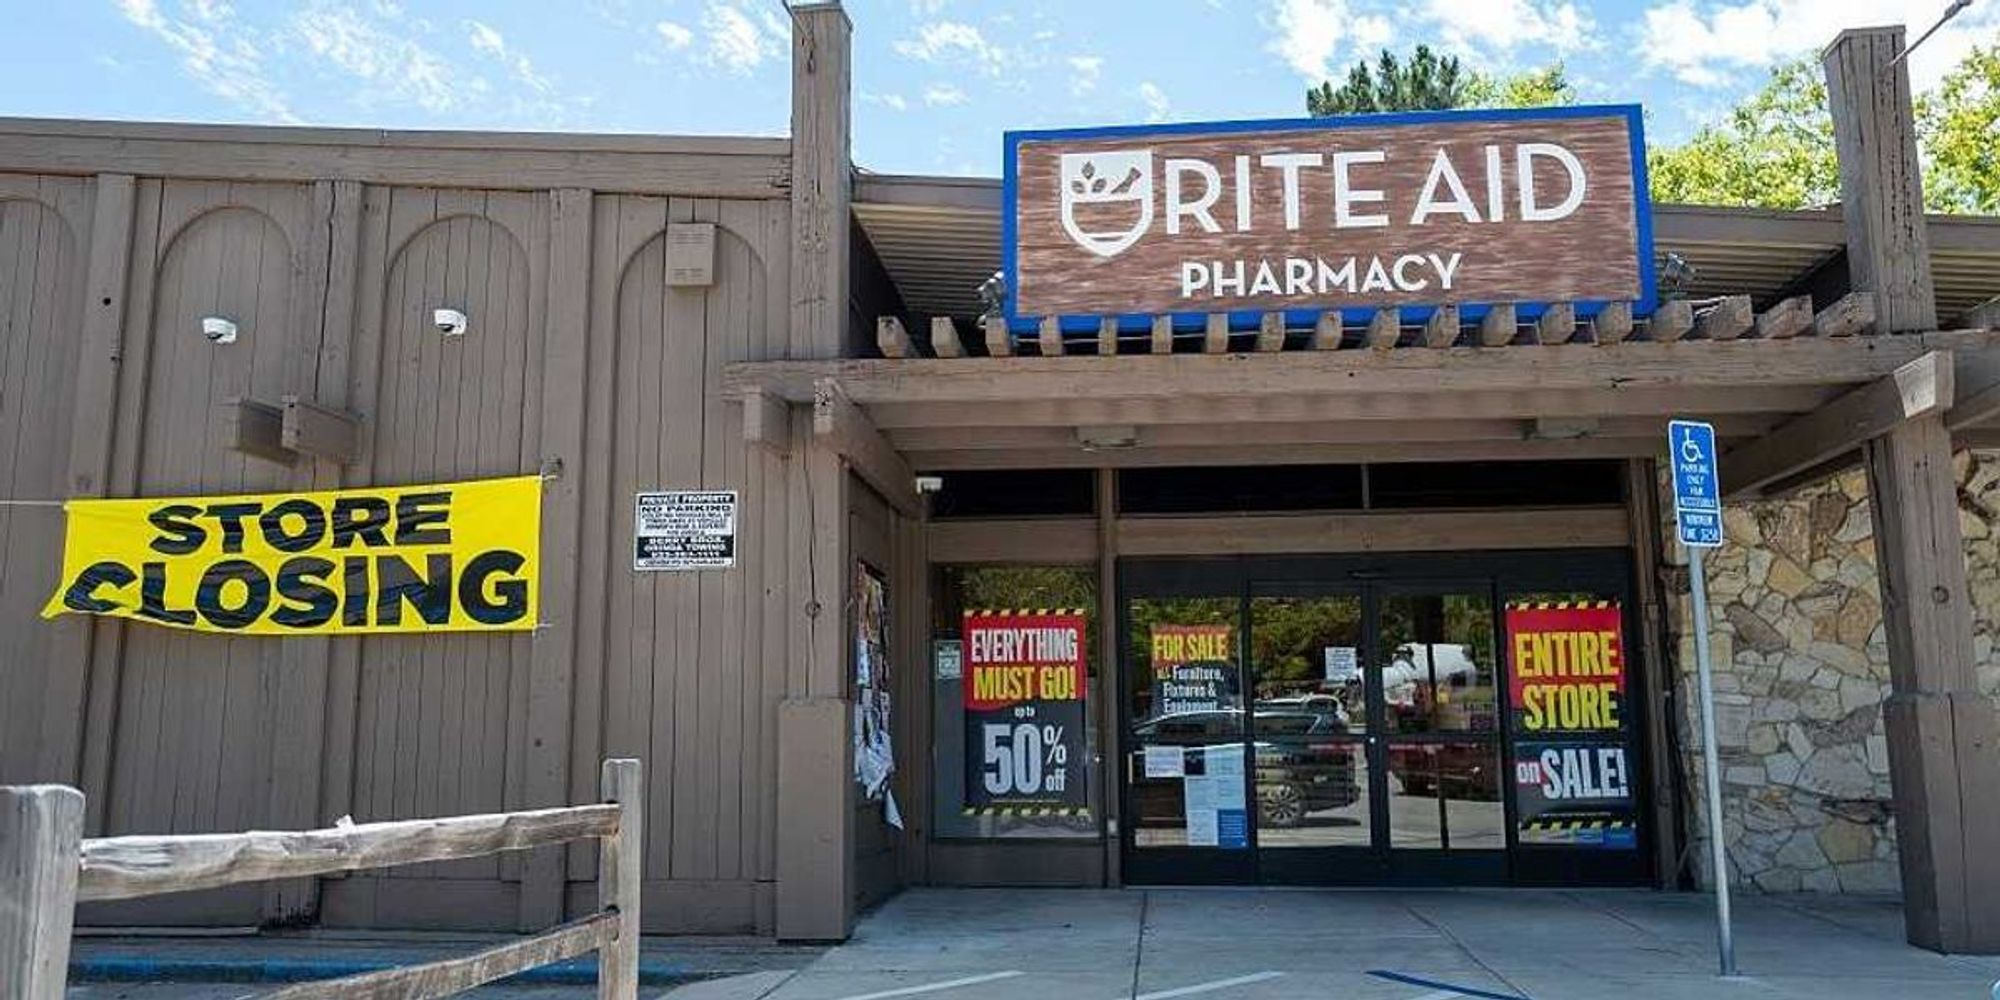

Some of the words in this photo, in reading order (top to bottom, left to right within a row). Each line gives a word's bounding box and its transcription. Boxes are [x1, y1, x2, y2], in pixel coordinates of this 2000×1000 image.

[1165, 150, 1389, 235] RITE
[1411, 141, 1588, 226] AID
[1181, 252, 1462, 298] PHARMACY
[148, 491, 453, 554] STORE
[63, 550, 528, 628] CLOSING
[971, 628, 1078, 662] EVERYTHING
[1152, 634, 1184, 661] FOR
[1187, 633, 1229, 661] SALE
[1514, 632, 1619, 677] ENTIRE
[973, 666, 1035, 700] MUST
[1039, 665, 1076, 700] GO!
[1163, 682, 1206, 697] Fixtures
[1208, 681, 1217, 697] &
[1173, 665, 1225, 682] Furniture,
[1014, 707, 1024, 718] up
[1026, 706, 1035, 717] to
[1523, 683, 1620, 730] STORE
[1045, 767, 1066, 791] off
[1516, 762, 1541, 784] on
[1541, 748, 1630, 799] SALE!
